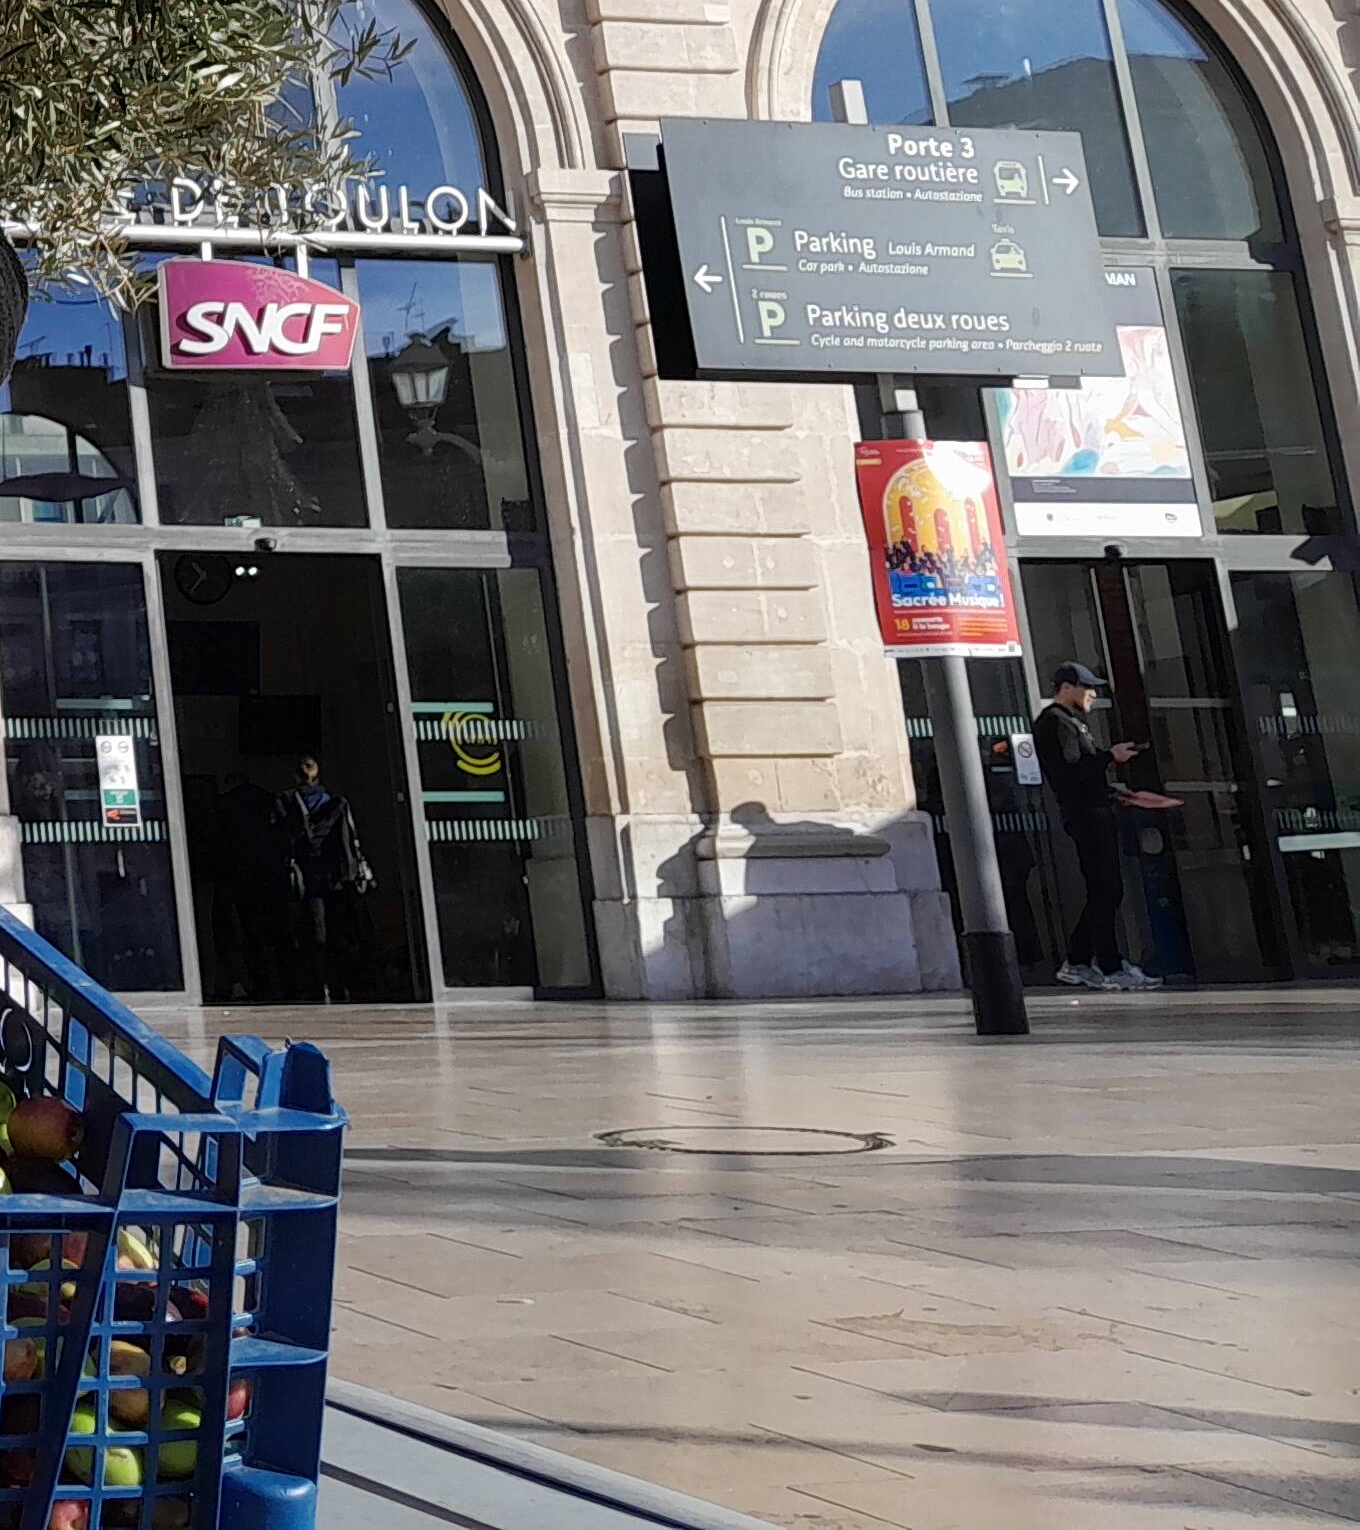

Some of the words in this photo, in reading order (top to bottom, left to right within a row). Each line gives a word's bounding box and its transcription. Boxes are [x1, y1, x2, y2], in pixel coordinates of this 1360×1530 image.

[887, 134, 953, 157] Porte
[960, 137, 975, 158] 3
[839, 158, 889, 180] Gare
[895, 161, 979, 184] routière
[843, 186, 864, 198] Bus
[866, 187, 904, 200] station
[913, 188, 983, 202] Autostazione
[794, 230, 877, 259] Parking
[888, 242, 922, 256] Louis
[924, 243, 975, 258] Armand
[798, 259, 818, 272] Car
[820, 260, 845, 274] park
[859, 262, 929, 276] Autostazione
[179, 301, 350, 354] SNCF
[806, 304, 889, 333] Parking
[894, 308, 946, 330] deux
[951, 313, 1010, 331] roues
[811, 334, 840, 348] Cycle
[843, 335, 864, 347] and
[867, 336, 926, 351] motorcycle
[929, 337, 968, 352] parking
[971, 340, 995, 350] area
[1065, 340, 1072, 351] 2
[891, 592, 947, 607] Sacrée
